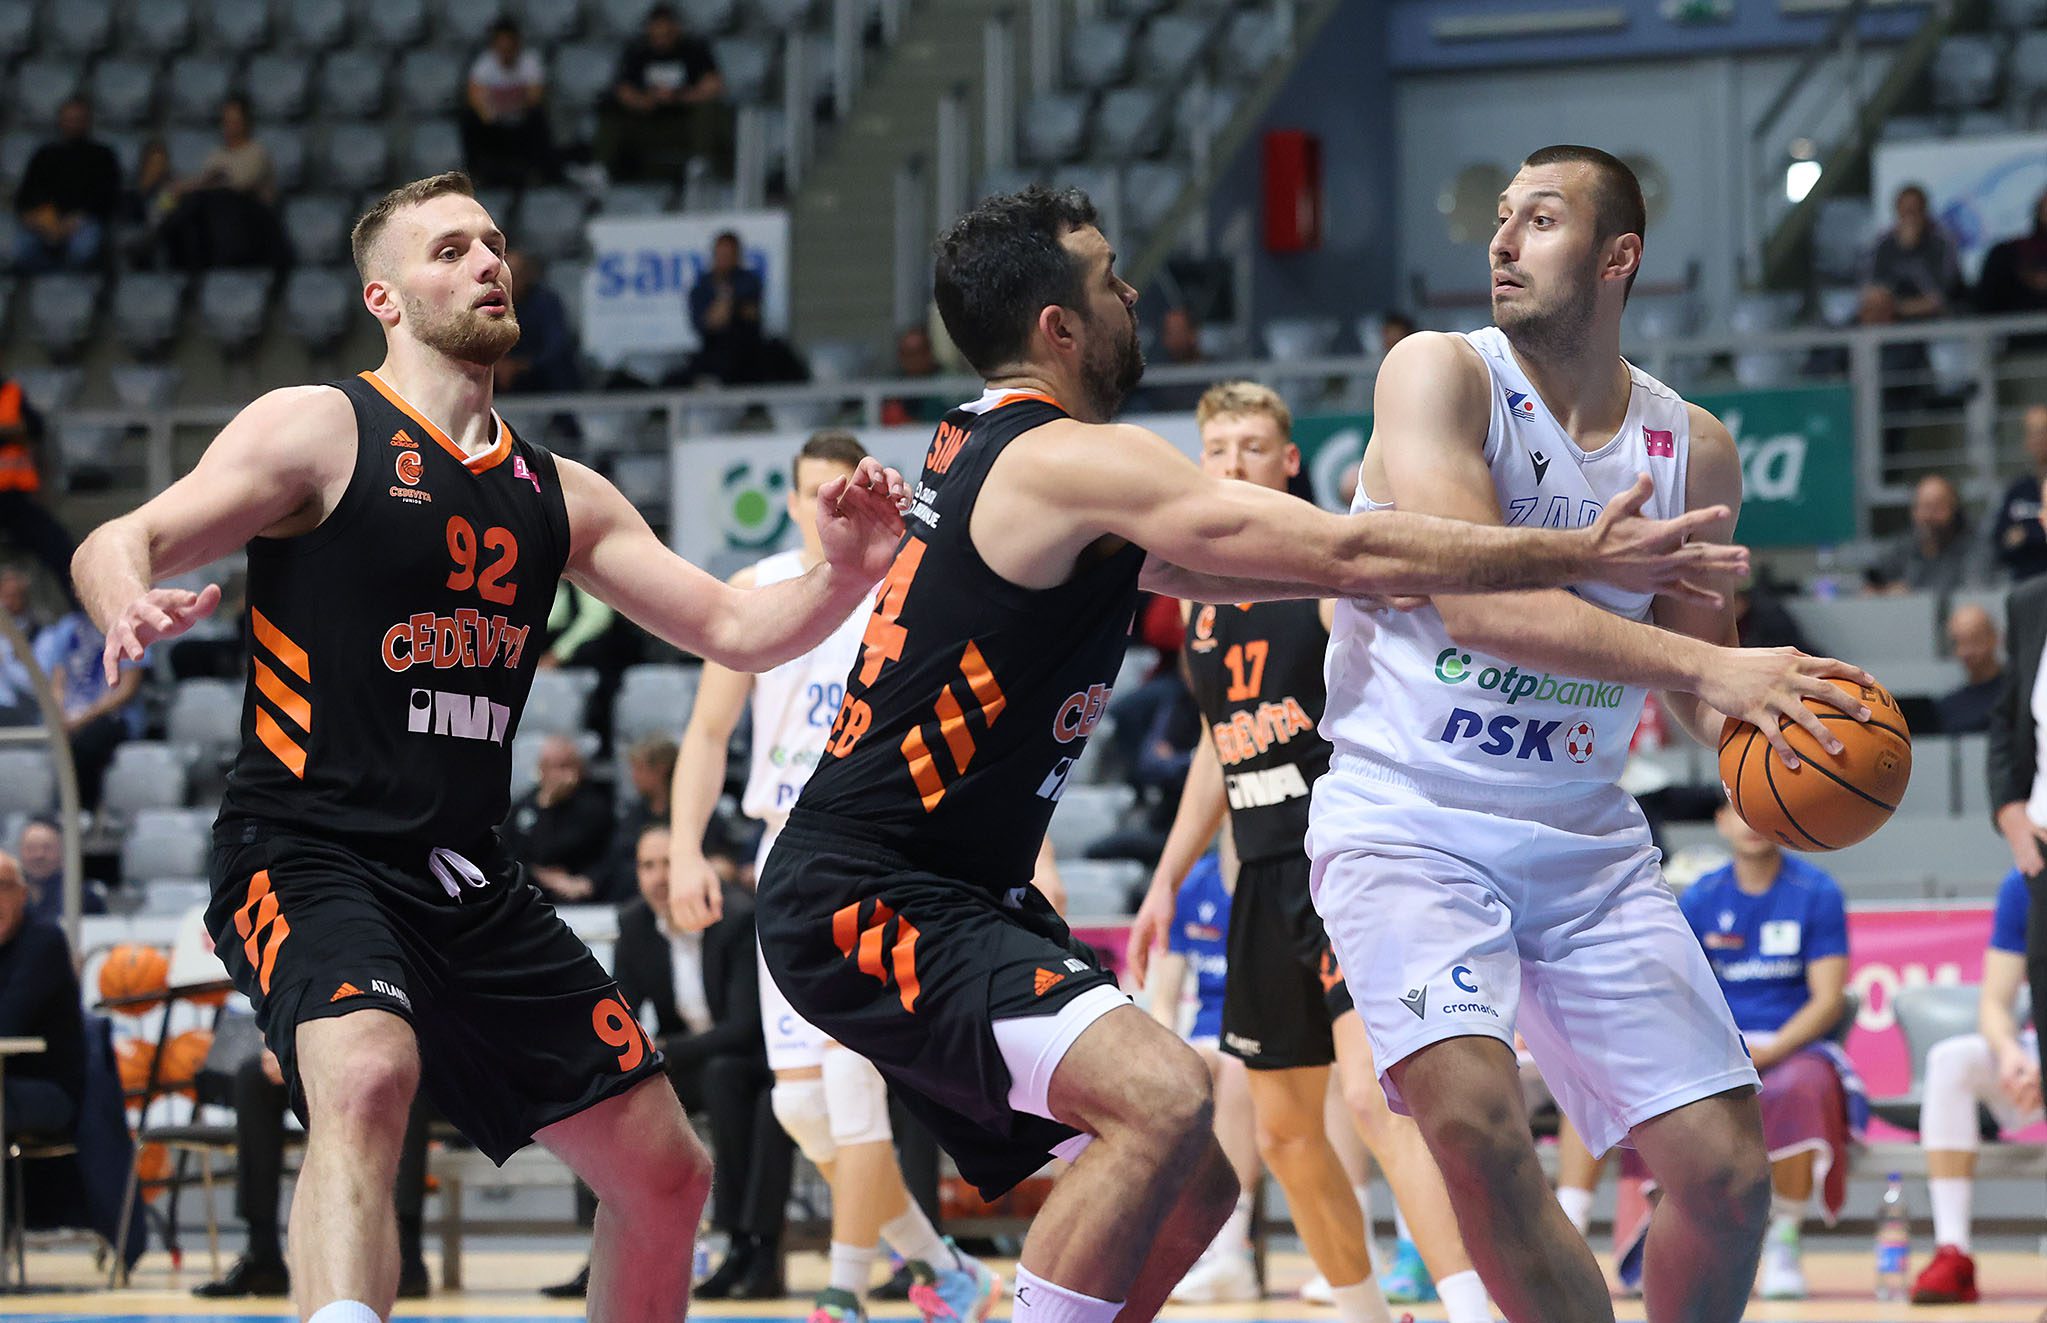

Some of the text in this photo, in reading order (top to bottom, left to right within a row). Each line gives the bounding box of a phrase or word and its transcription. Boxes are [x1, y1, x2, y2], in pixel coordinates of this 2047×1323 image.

[446, 514, 519, 606] 92
[857, 528, 928, 689] 4
[806, 682, 844, 727] 29
[1223, 638, 1270, 703] 17
[1440, 707, 1563, 762] PSK
[592, 988, 656, 1073] 9
